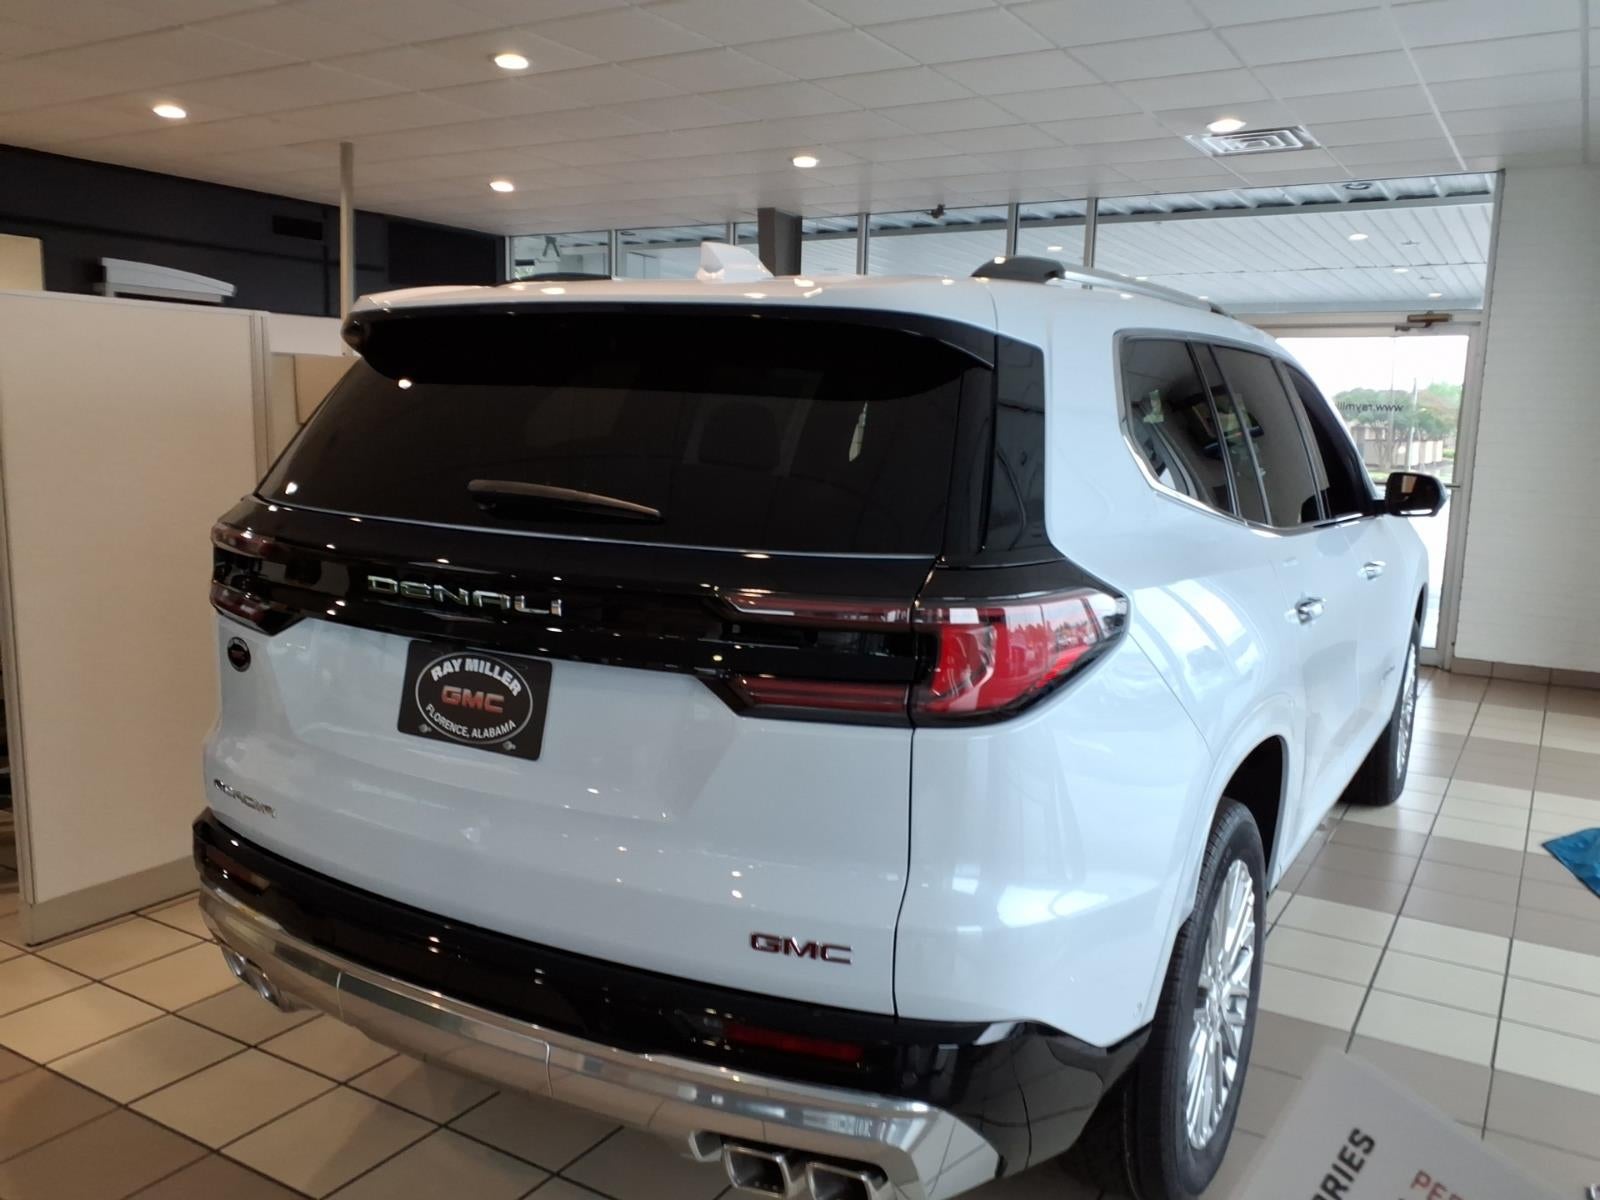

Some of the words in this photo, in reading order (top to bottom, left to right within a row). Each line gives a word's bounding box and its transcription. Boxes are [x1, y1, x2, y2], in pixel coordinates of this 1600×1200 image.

[367, 575, 562, 617] DENALI
[430, 658, 463, 681] RAY
[465, 658, 522, 696] MILLER
[441, 685, 505, 713] GMC
[425, 703, 470, 738] FLORENCE,
[471, 719, 517, 739] ALABAMA
[749, 931, 853, 966] GMC
